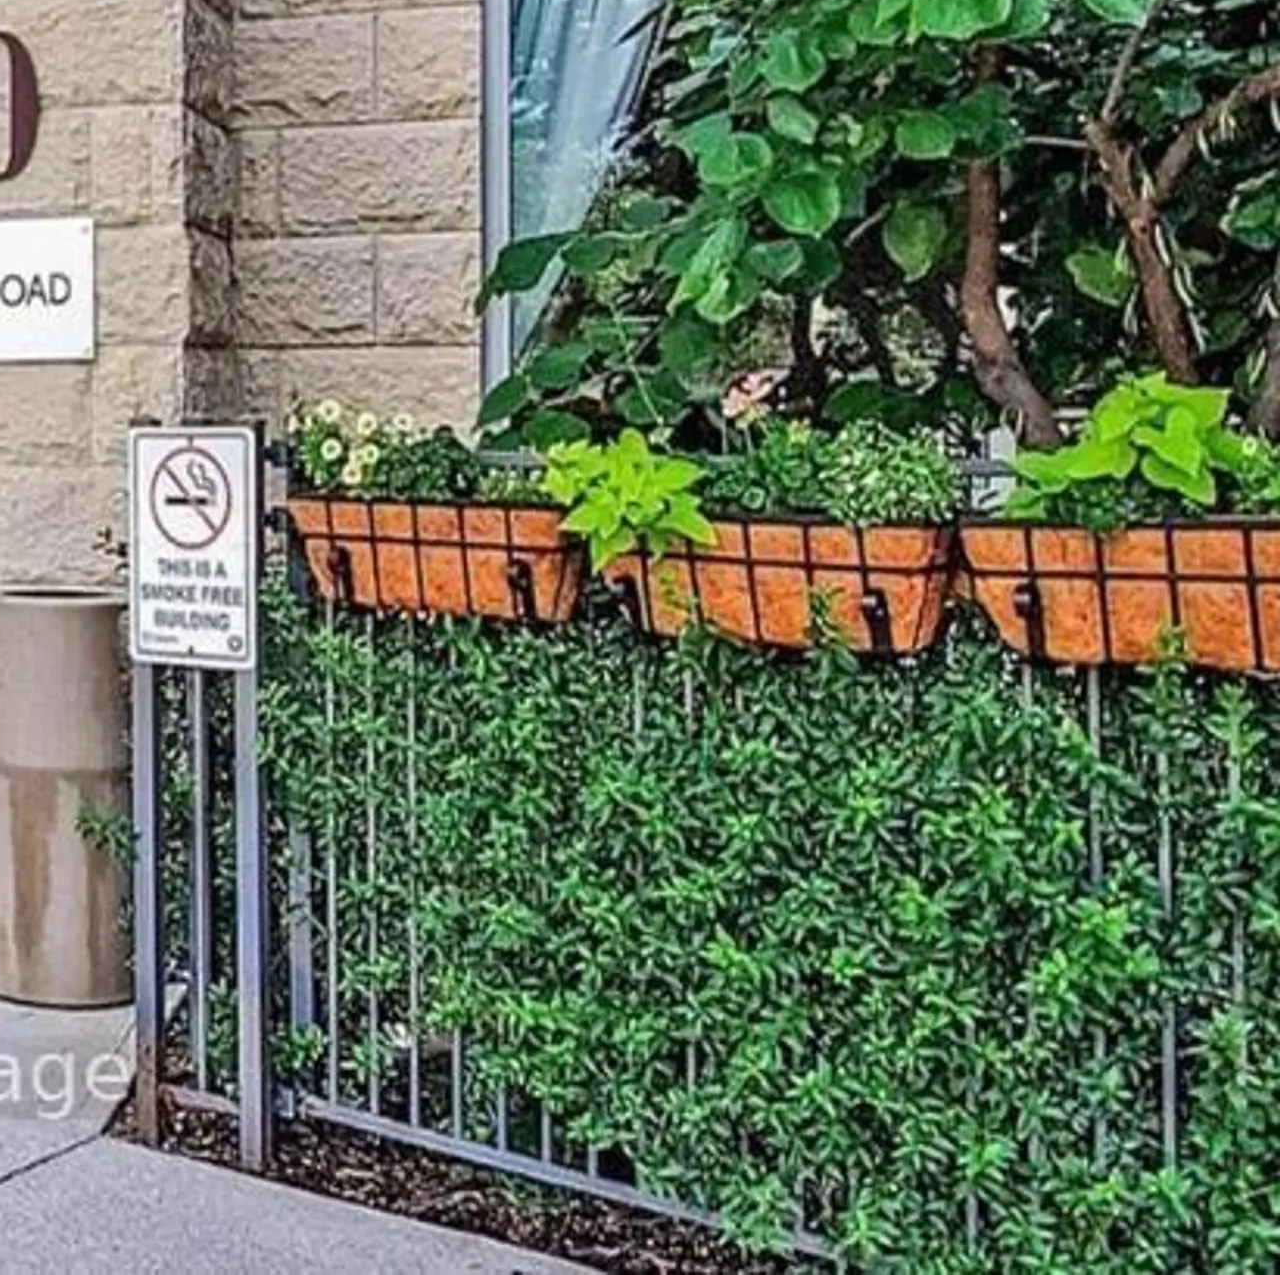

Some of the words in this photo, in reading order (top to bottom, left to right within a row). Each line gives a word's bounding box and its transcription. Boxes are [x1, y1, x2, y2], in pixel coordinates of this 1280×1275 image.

[157, 557, 191, 576] THIS
[195, 559, 211, 577] IS
[214, 561, 228, 579] A
[141, 582, 197, 602] SMOKE
[201, 585, 244, 606] FREE
[153, 607, 231, 631] BUILDING
